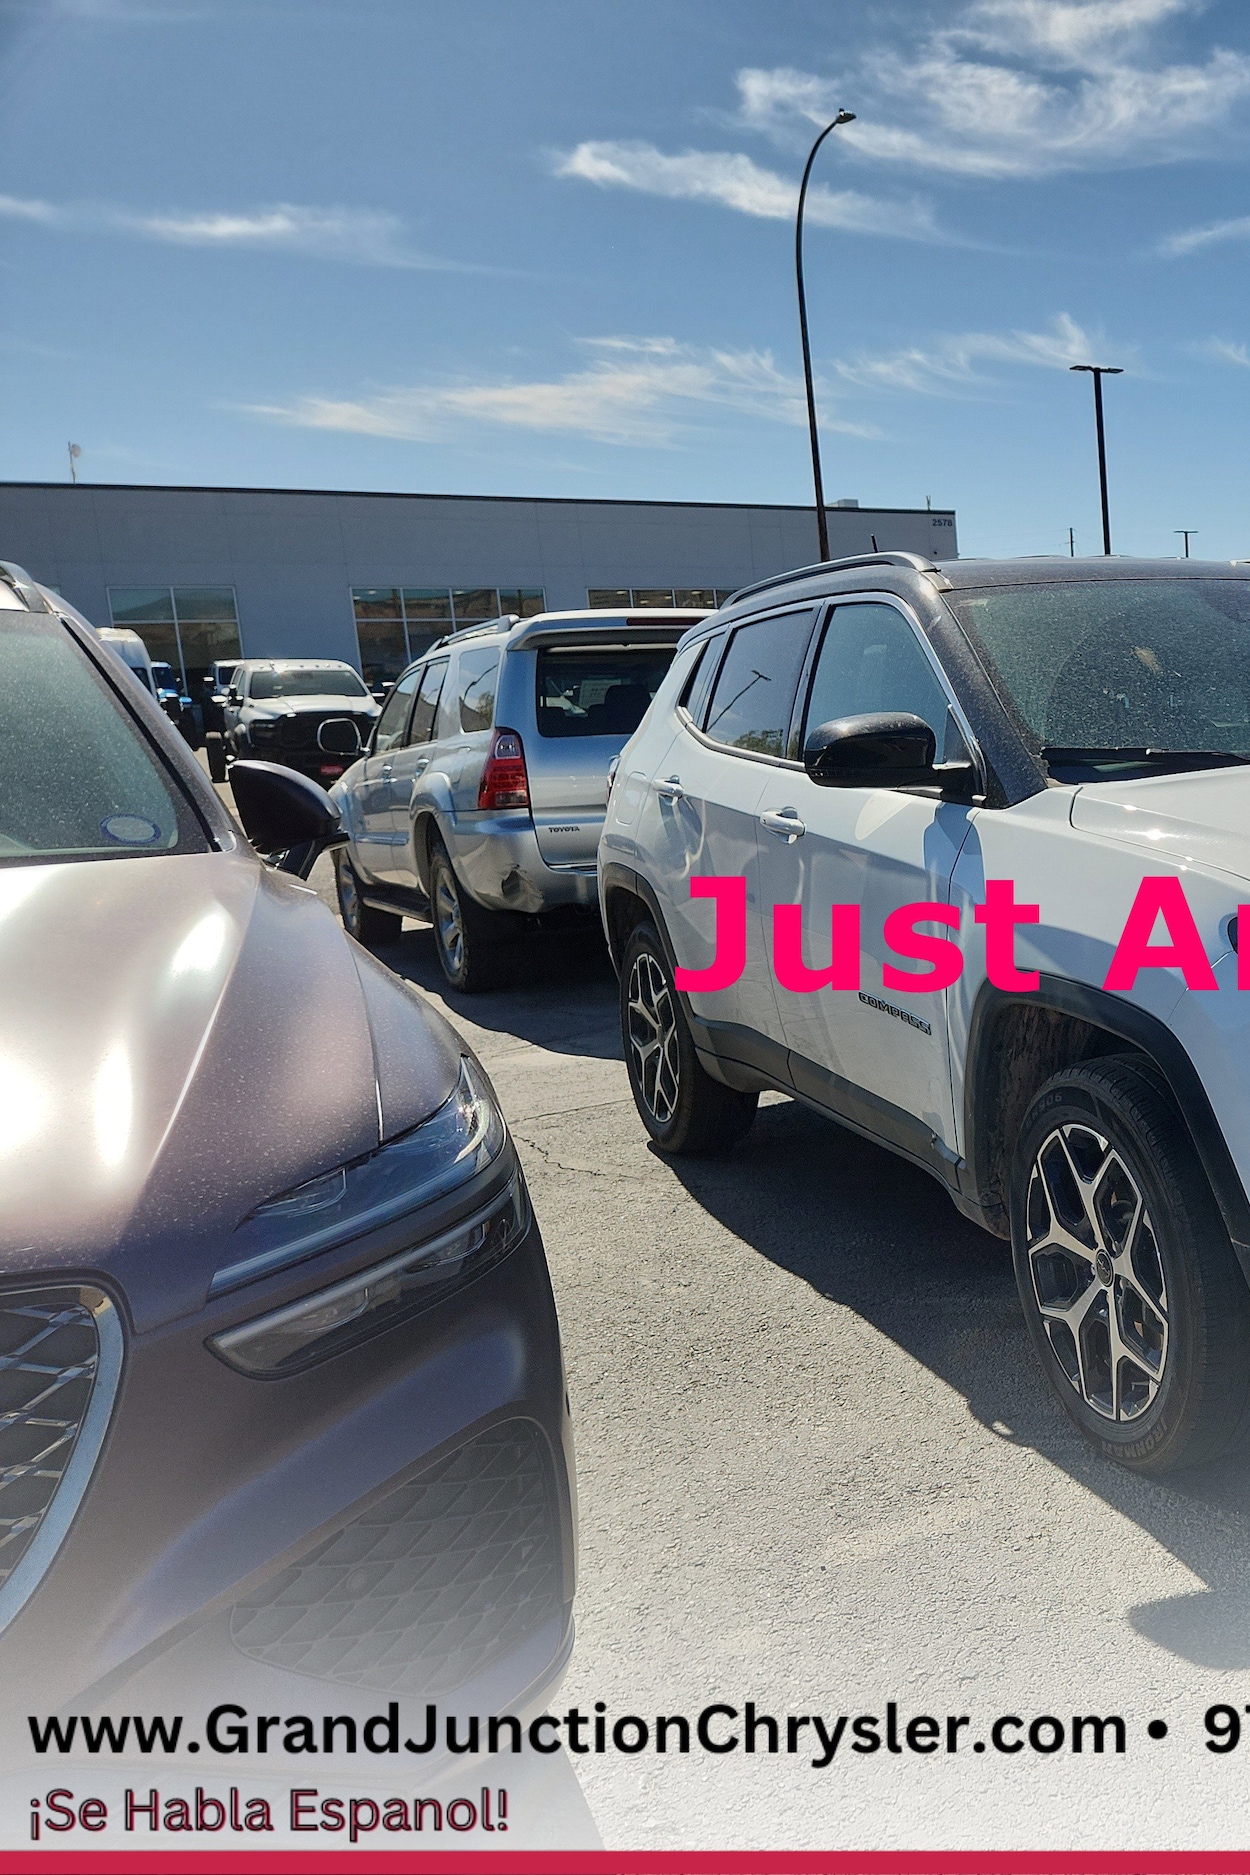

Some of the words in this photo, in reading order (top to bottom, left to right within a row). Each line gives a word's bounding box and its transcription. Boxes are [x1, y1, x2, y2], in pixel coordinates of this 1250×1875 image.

[932, 518, 953, 527] 2578
[548, 826, 581, 834] TOYOTA
[858, 991, 932, 1036] COMPASS
